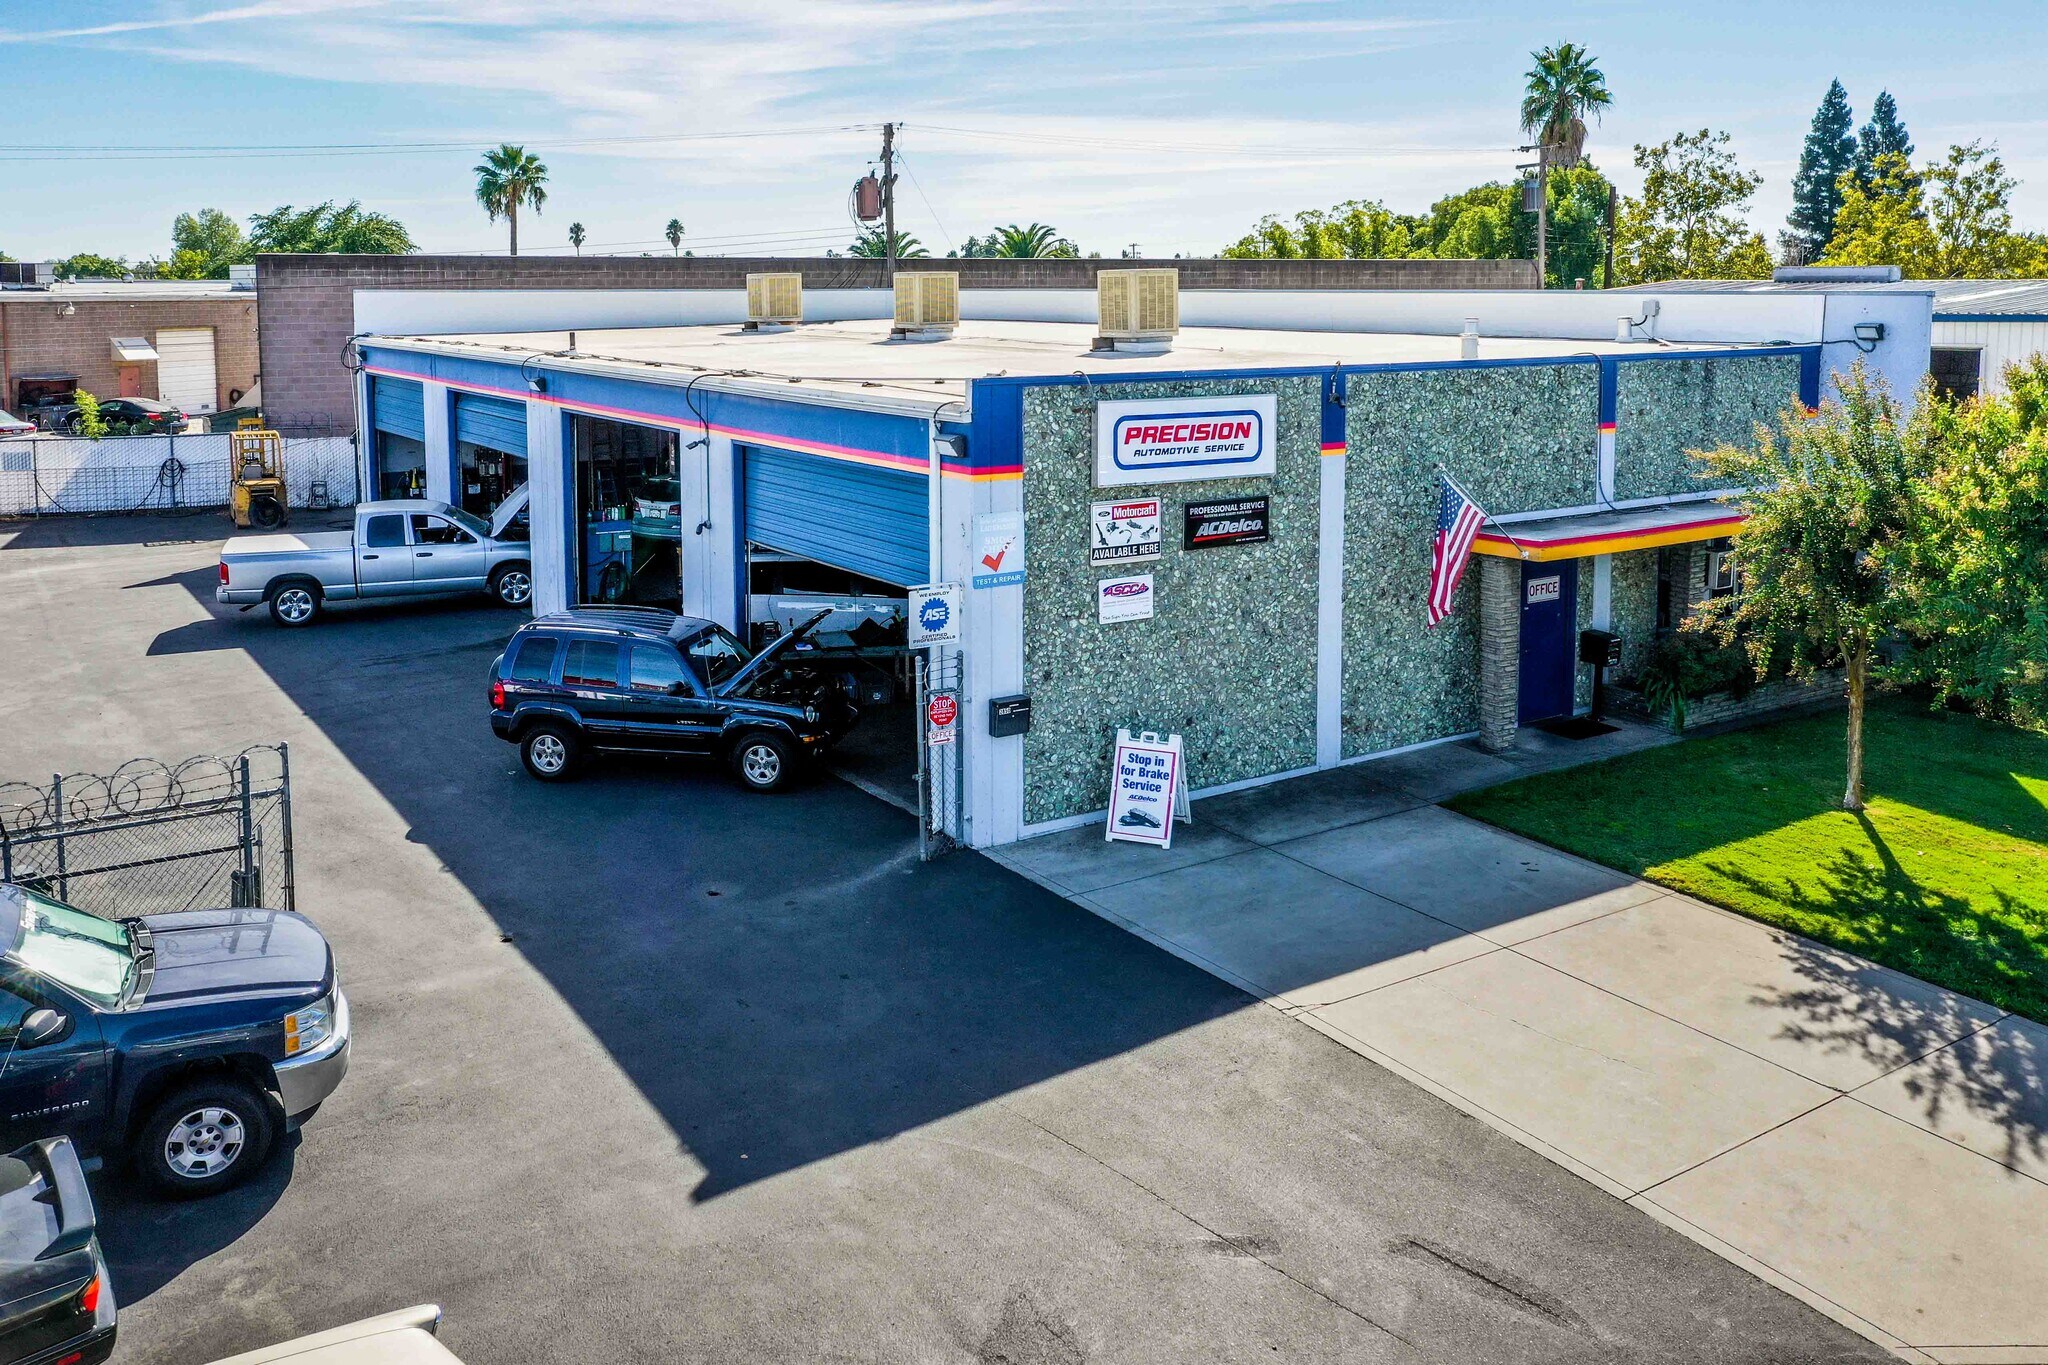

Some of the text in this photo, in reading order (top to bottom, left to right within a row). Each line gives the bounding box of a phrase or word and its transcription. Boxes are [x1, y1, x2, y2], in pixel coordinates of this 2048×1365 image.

[1124, 422, 1252, 445] PRECISION
[1133, 443, 1245, 457] AUTOMOTIVE SERVICE
[1113, 504, 1156, 518] Motorcraft
[1189, 500, 1265, 515] PROFESSIONAL SERVICE
[1195, 518, 1262, 537] ACDelco
[1092, 543, 1159, 560] AVAILABLE HERE
[976, 577, 991, 586] TEST
[999, 574, 1021, 583] REPAIR
[1103, 582, 1147, 597] ASCCA
[1529, 581, 1558, 597] OFFICE
[923, 607, 946, 622] ASE
[921, 632, 948, 640] CERTIFIED
[933, 699, 952, 709] STOP
[931, 730, 953, 740] OFFICE
[1128, 753, 1165, 767] Stop in
[1120, 765, 1170, 780] for Brake
[1122, 778, 1162, 792] Service
[1128, 794, 1157, 802] ACDelco
[11, 1099, 90, 1120] SILVERADO
